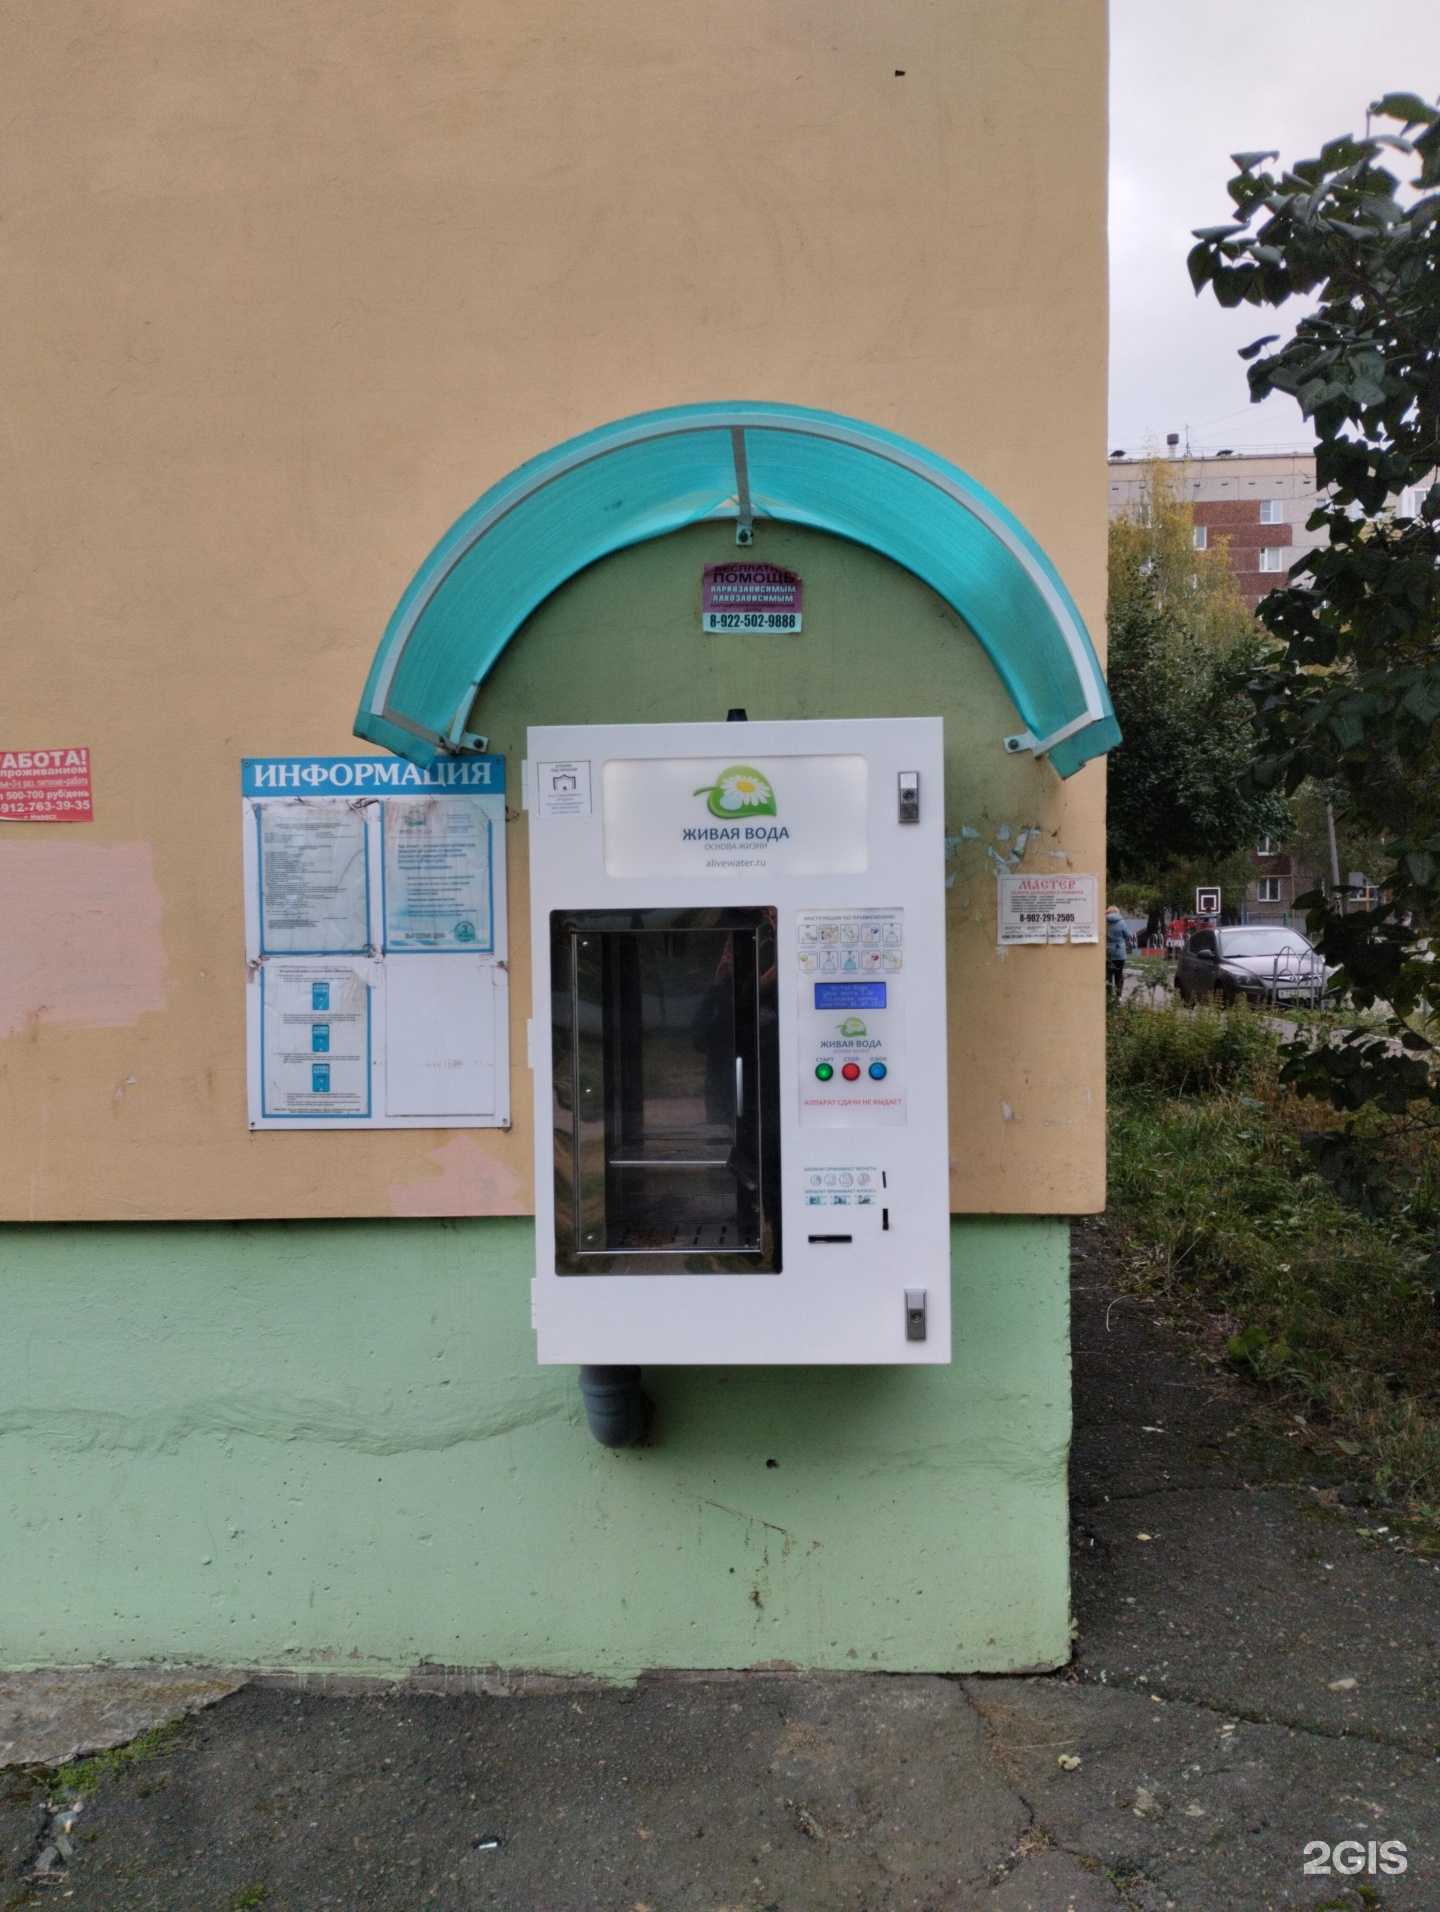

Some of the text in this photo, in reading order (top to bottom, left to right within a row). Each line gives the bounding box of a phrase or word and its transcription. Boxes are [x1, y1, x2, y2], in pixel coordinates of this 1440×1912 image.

[713, 572, 795, 583] ПОМОЩЬ
[710, 614, 796, 628] 8-922-502-9888
[0, 750, 87, 769] АБОТА!
[254, 762, 492, 787] ИНФОРМАЦИЯ
[682, 826, 790, 842] ЖИВАЯ ВОДА
[820, 1040, 882, 1049] ЖИВАЯ ВОДА
